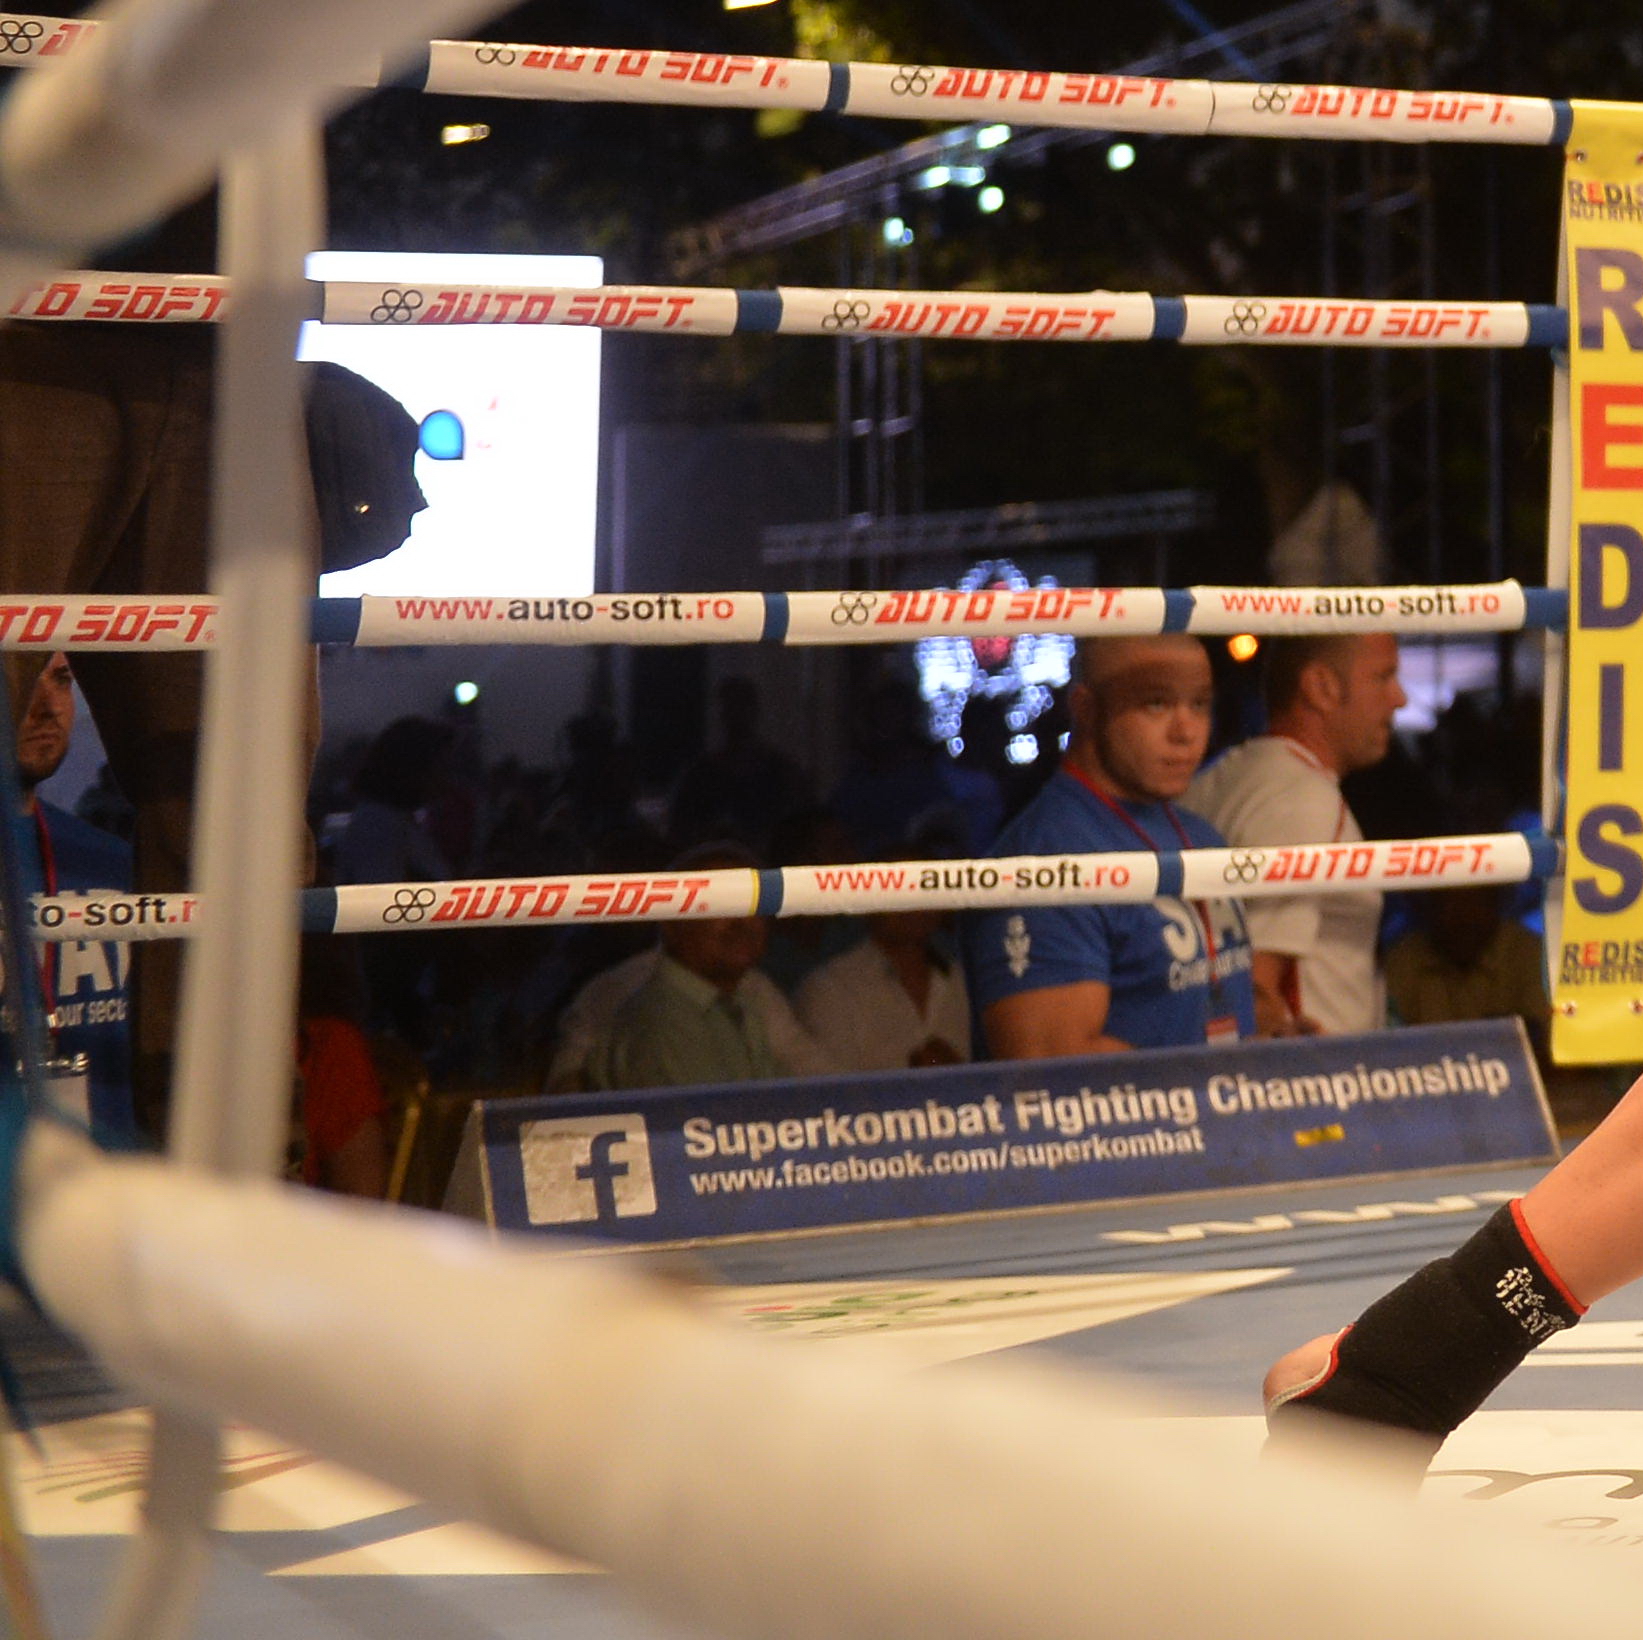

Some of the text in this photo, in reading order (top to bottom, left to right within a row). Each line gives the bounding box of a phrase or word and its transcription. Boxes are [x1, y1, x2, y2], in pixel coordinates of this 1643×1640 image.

[932, 69, 1174, 108] AUTO SOFT
[1290, 88, 1508, 124] AUTO SOFT
[419, 292, 696, 330] AUTO SOFT
[868, 303, 1116, 339] AUTO SOFT
[1264, 303, 1491, 339] AUTO SOFT
[396, 596, 734, 623] www.auto-soft.ro
[874, 588, 1124, 622] AUTO SOFT
[1221, 581, 1500, 617] www.auto-soft.ro
[816, 860, 1131, 892] www.auto-soft.ro
[1263, 843, 1498, 882] AUTO SOFT
[430, 879, 710, 922] AUTO SOFT
[682, 1050, 1512, 1160] Superkombat Fighting Championship
[688, 1126, 1205, 1196] www.facebook.com/superkombat
